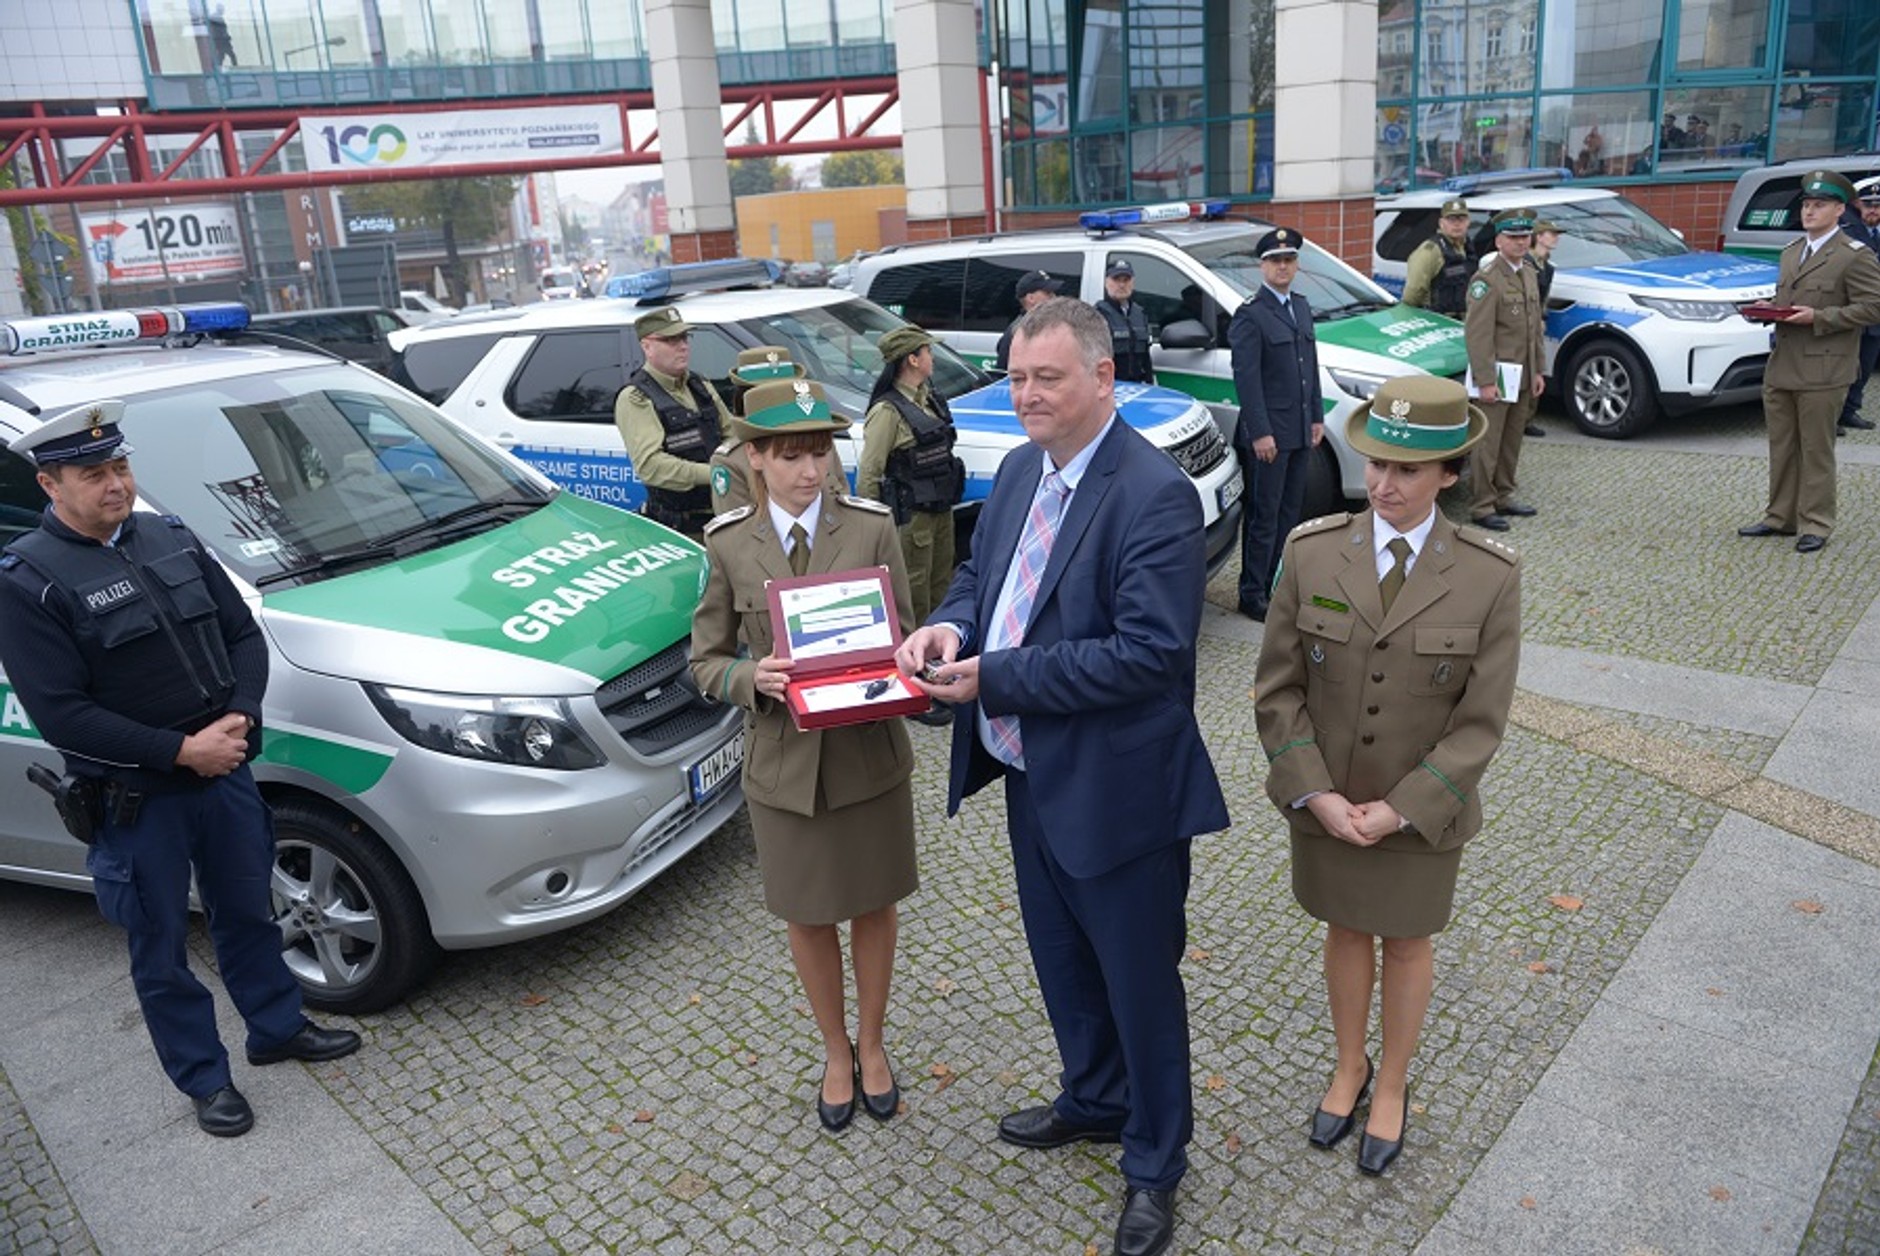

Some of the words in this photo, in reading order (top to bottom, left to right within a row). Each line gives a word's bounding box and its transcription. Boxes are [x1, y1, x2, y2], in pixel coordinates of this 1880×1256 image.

[321, 124, 407, 164] 100
[417, 131, 435, 140] LAT
[439, 127, 518, 138] UNIWERSYTETU
[136, 214, 202, 250] 120
[23, 328, 136, 348] GRANICZNA
[48, 318, 111, 334] STRAŻ
[575, 484, 631, 503] PATROL
[492, 530, 618, 588] STRAŻ
[86, 580, 135, 608] POLIZEI
[502, 541, 697, 643] GRANICZNA
